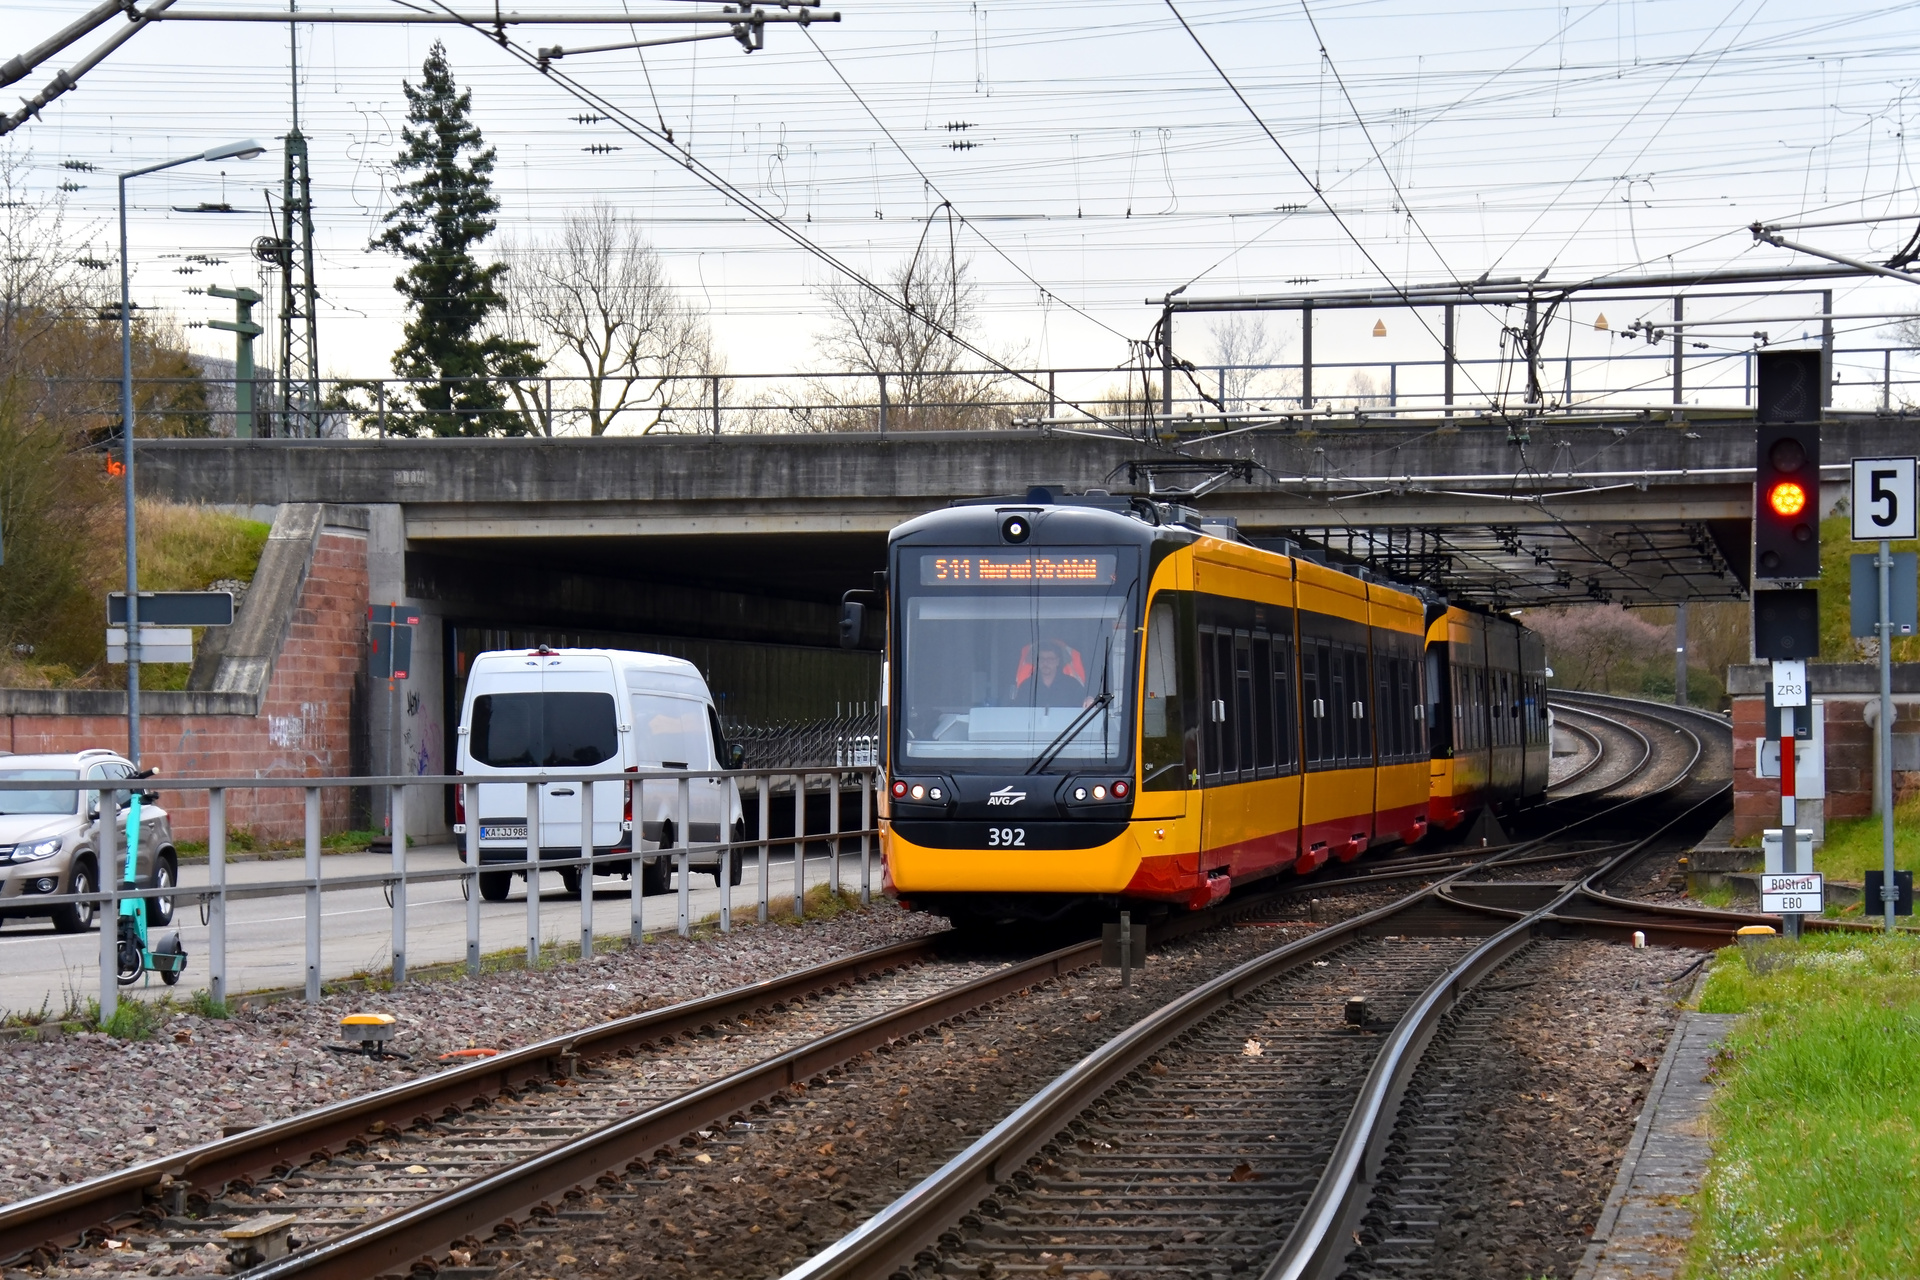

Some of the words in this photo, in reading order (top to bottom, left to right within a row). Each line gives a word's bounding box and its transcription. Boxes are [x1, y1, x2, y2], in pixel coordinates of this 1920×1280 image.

[1871, 470, 1897, 527] 5
[935, 558, 970, 579] S11
[1786, 671, 1792, 681] 1
[1777, 685, 1802, 695] ZR3
[987, 796, 1010, 806] AVG
[485, 828, 496, 837] KA
[988, 827, 1026, 847] 392
[1771, 878, 1813, 891] BOStrab
[1782, 897, 1802, 909] EBO
